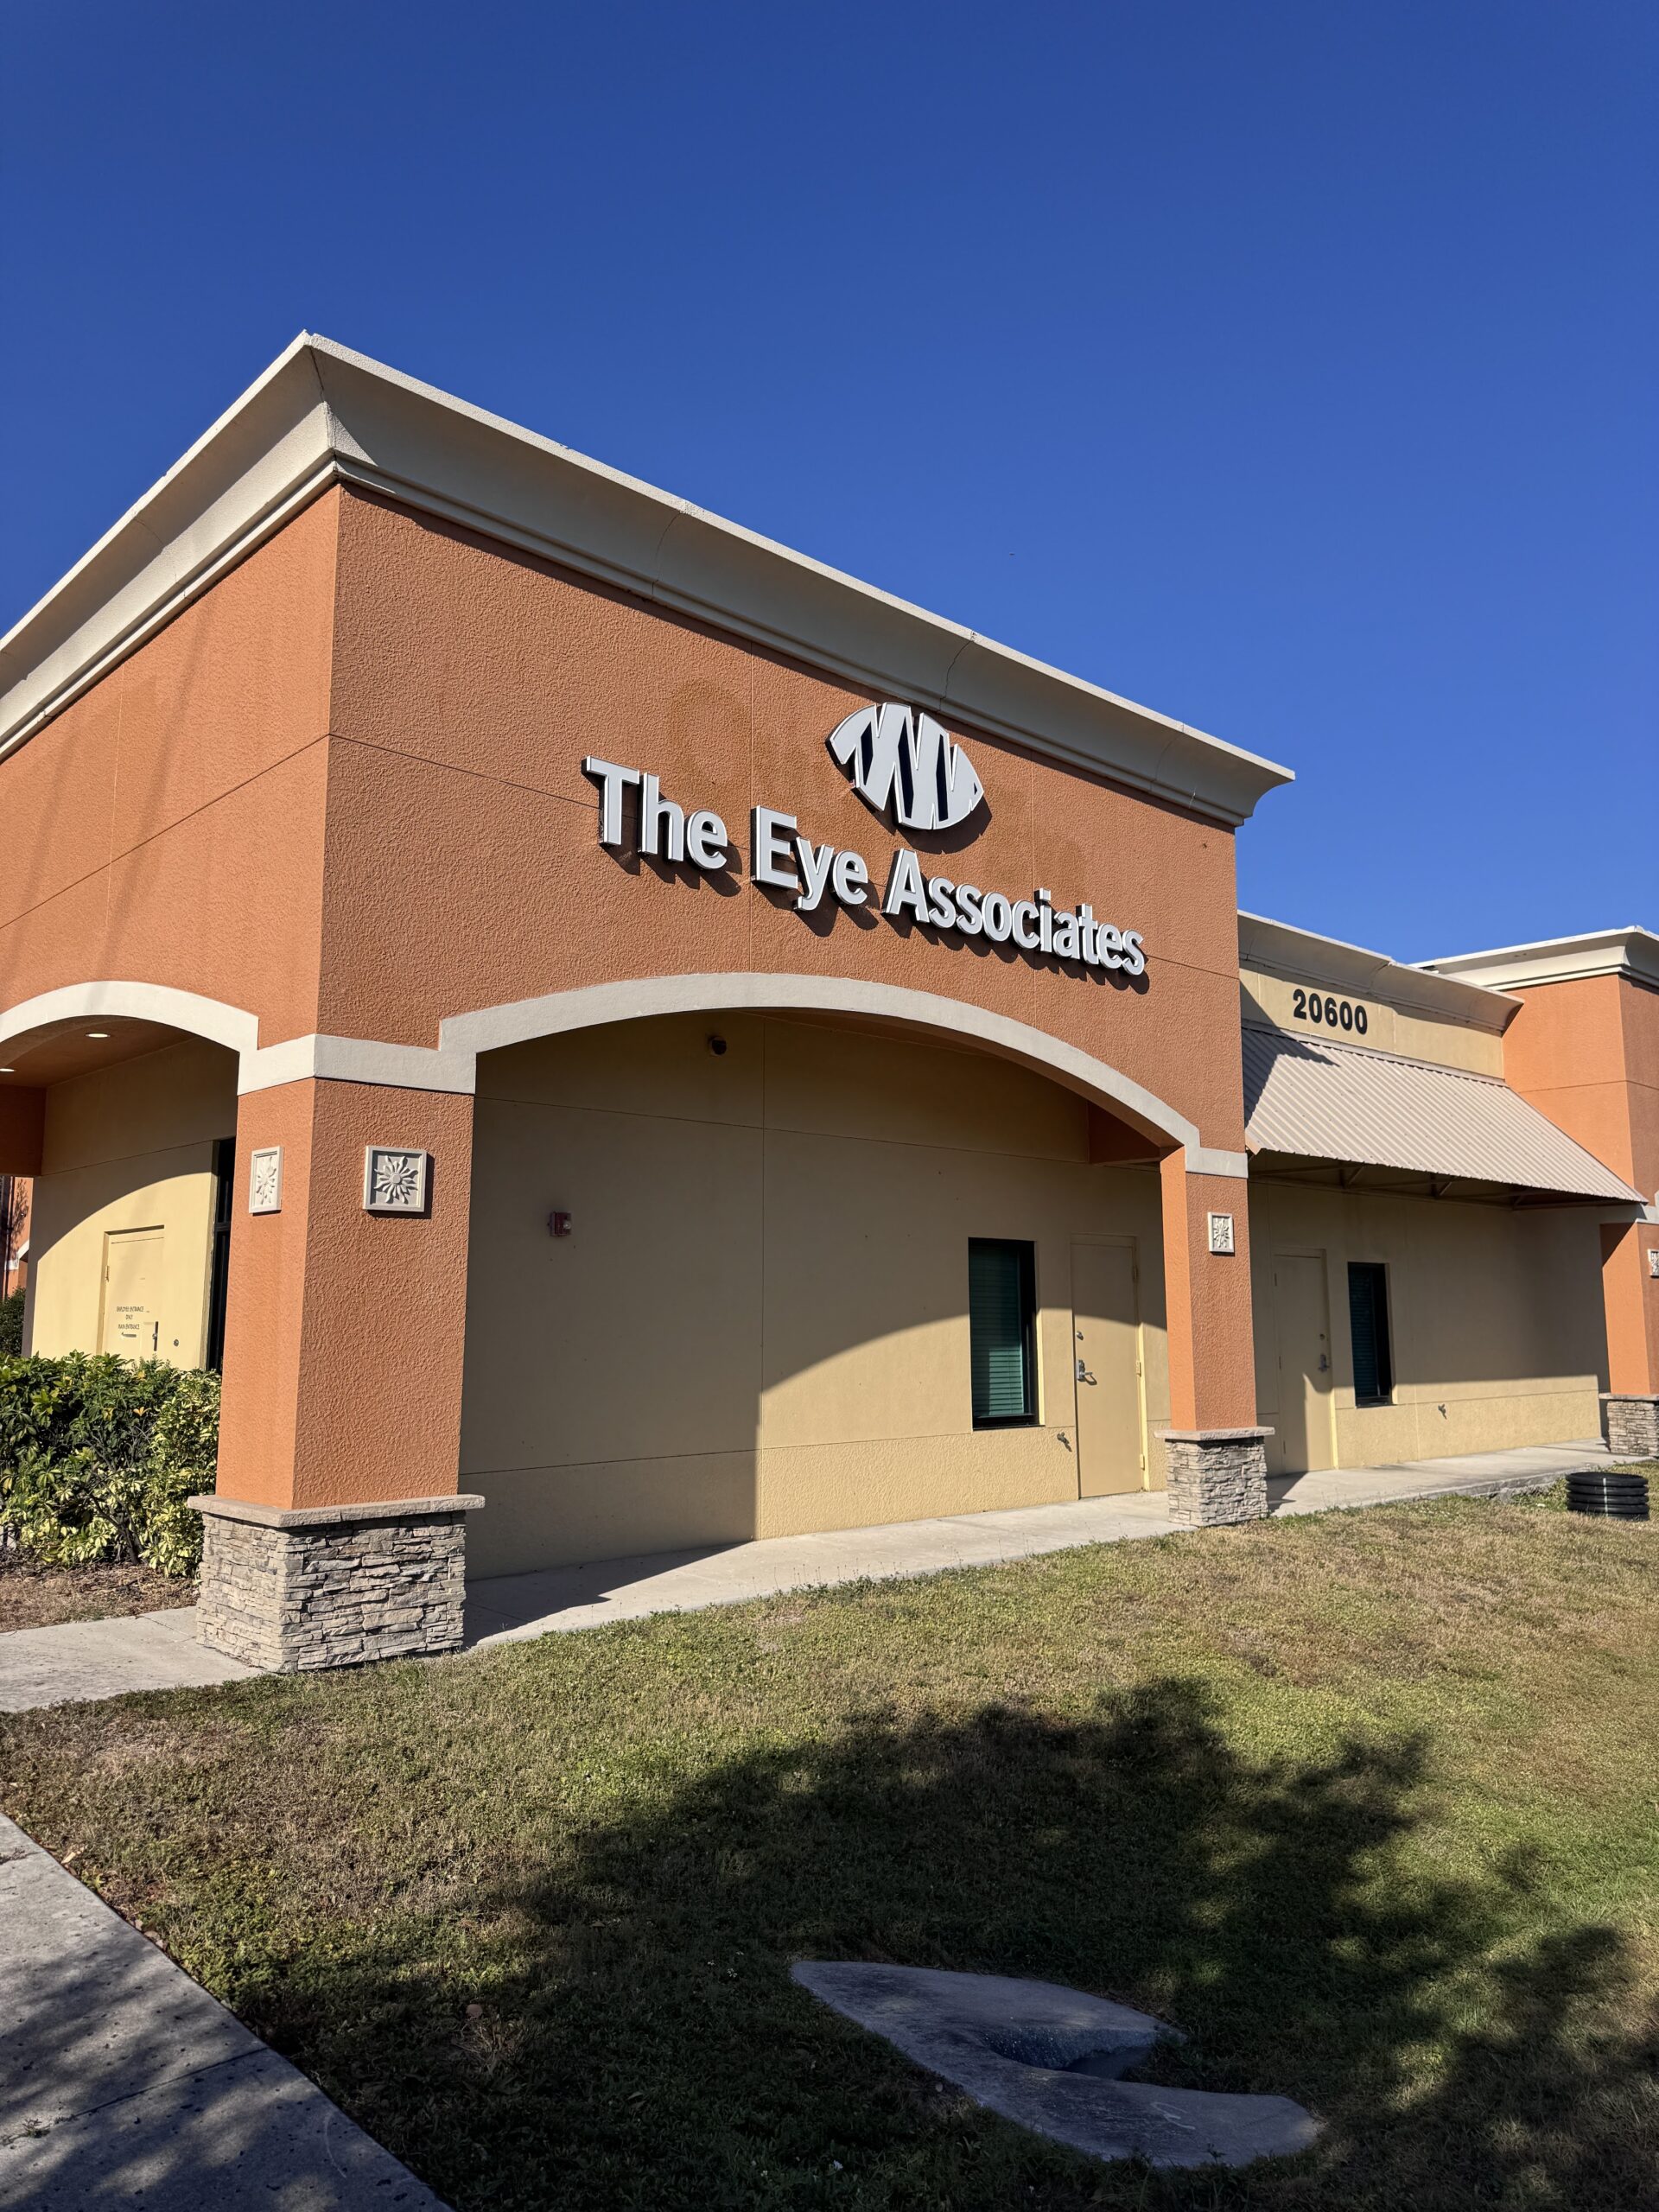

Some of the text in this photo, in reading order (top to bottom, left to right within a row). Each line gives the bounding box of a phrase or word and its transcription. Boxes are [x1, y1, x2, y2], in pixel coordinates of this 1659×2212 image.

[582, 754, 1146, 976] The Eye Associates
[1293, 988, 1368, 1035] 20600
